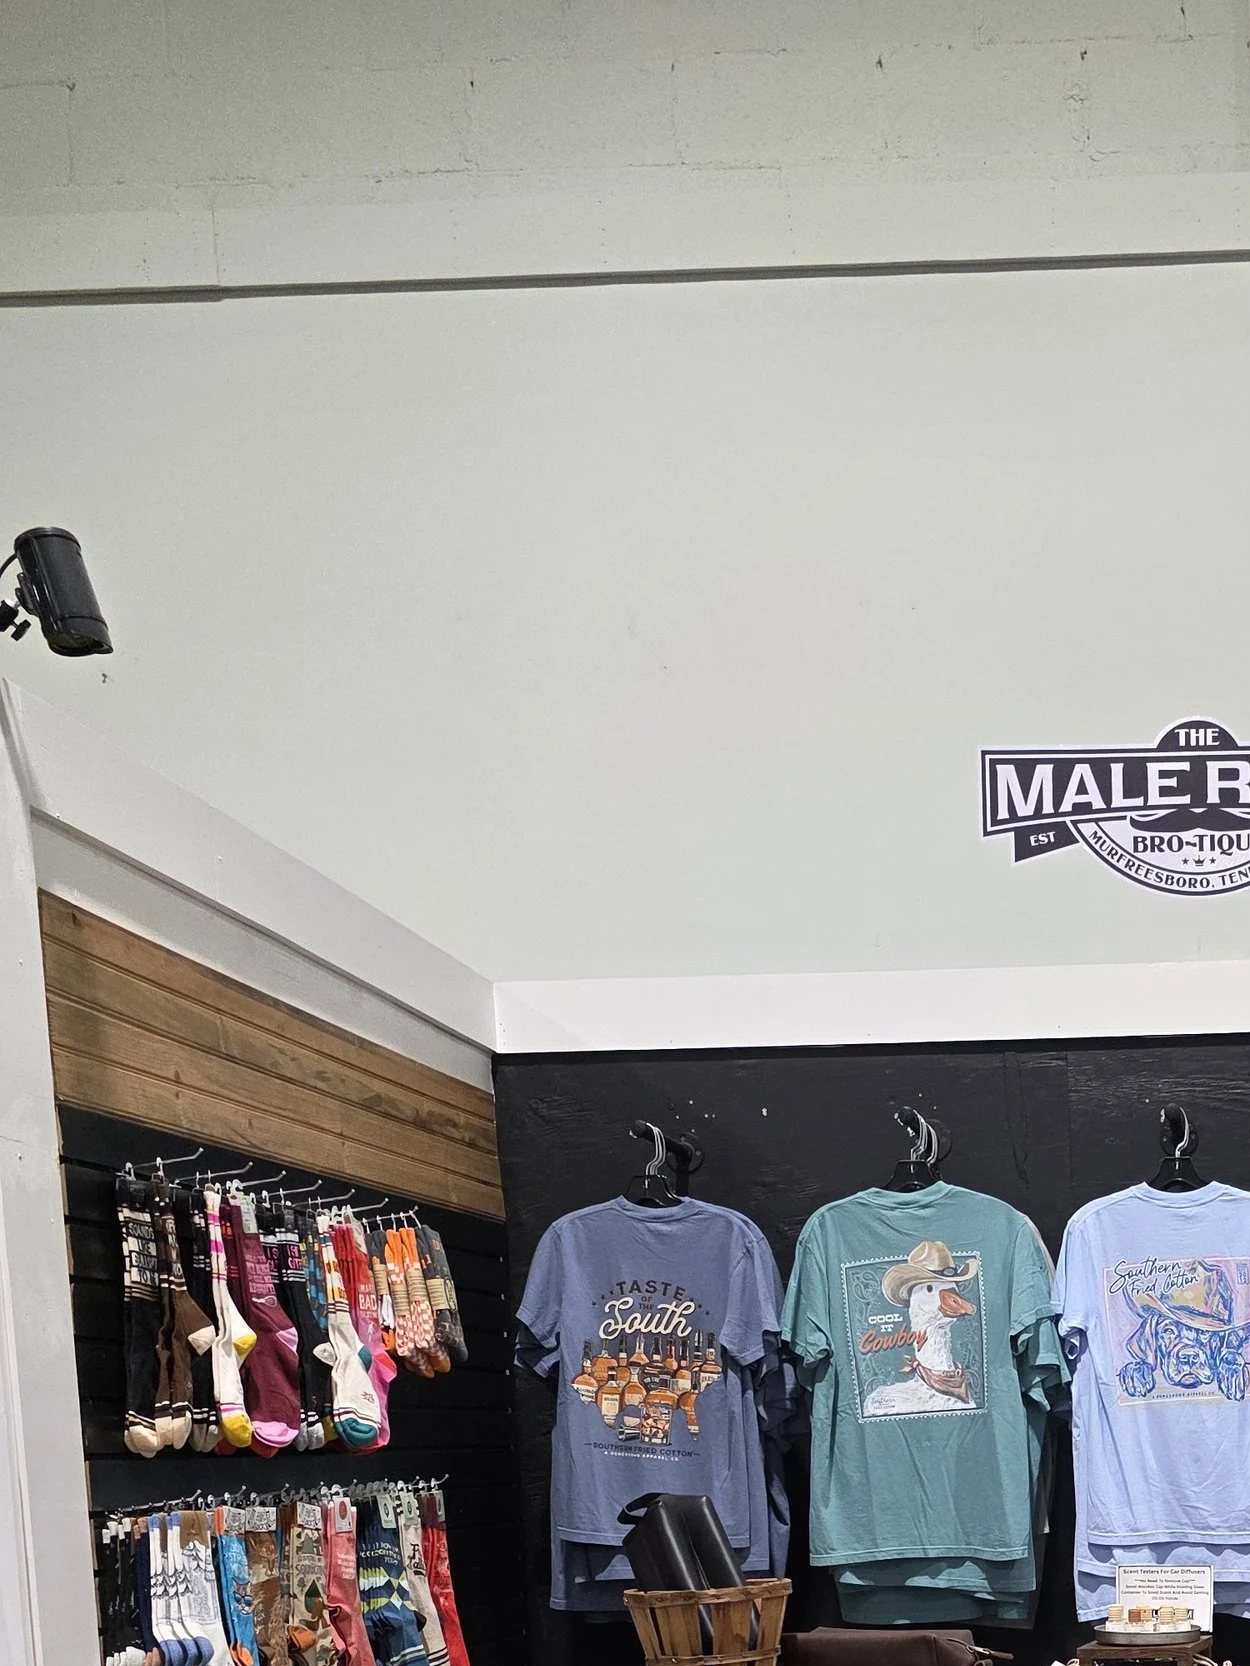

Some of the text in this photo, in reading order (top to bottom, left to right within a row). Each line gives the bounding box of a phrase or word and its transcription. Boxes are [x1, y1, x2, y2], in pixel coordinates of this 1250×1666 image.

[1174, 728, 1220, 747] THE
[995, 761, 1191, 820] MALE
[1029, 831, 1056, 846] EST
[1109, 1255, 1182, 1294] Southern
[1130, 1273, 1200, 1296] Fried Cotton
[616, 1279, 686, 1300] TASTE
[360, 1294, 378, 1311] BAD
[598, 1296, 695, 1339] South
[868, 1313, 903, 1325] COOL
[880, 1324, 894, 1332] IT
[858, 1328, 928, 1356] Cowboy
[660, 1448, 694, 1457] COTTON
